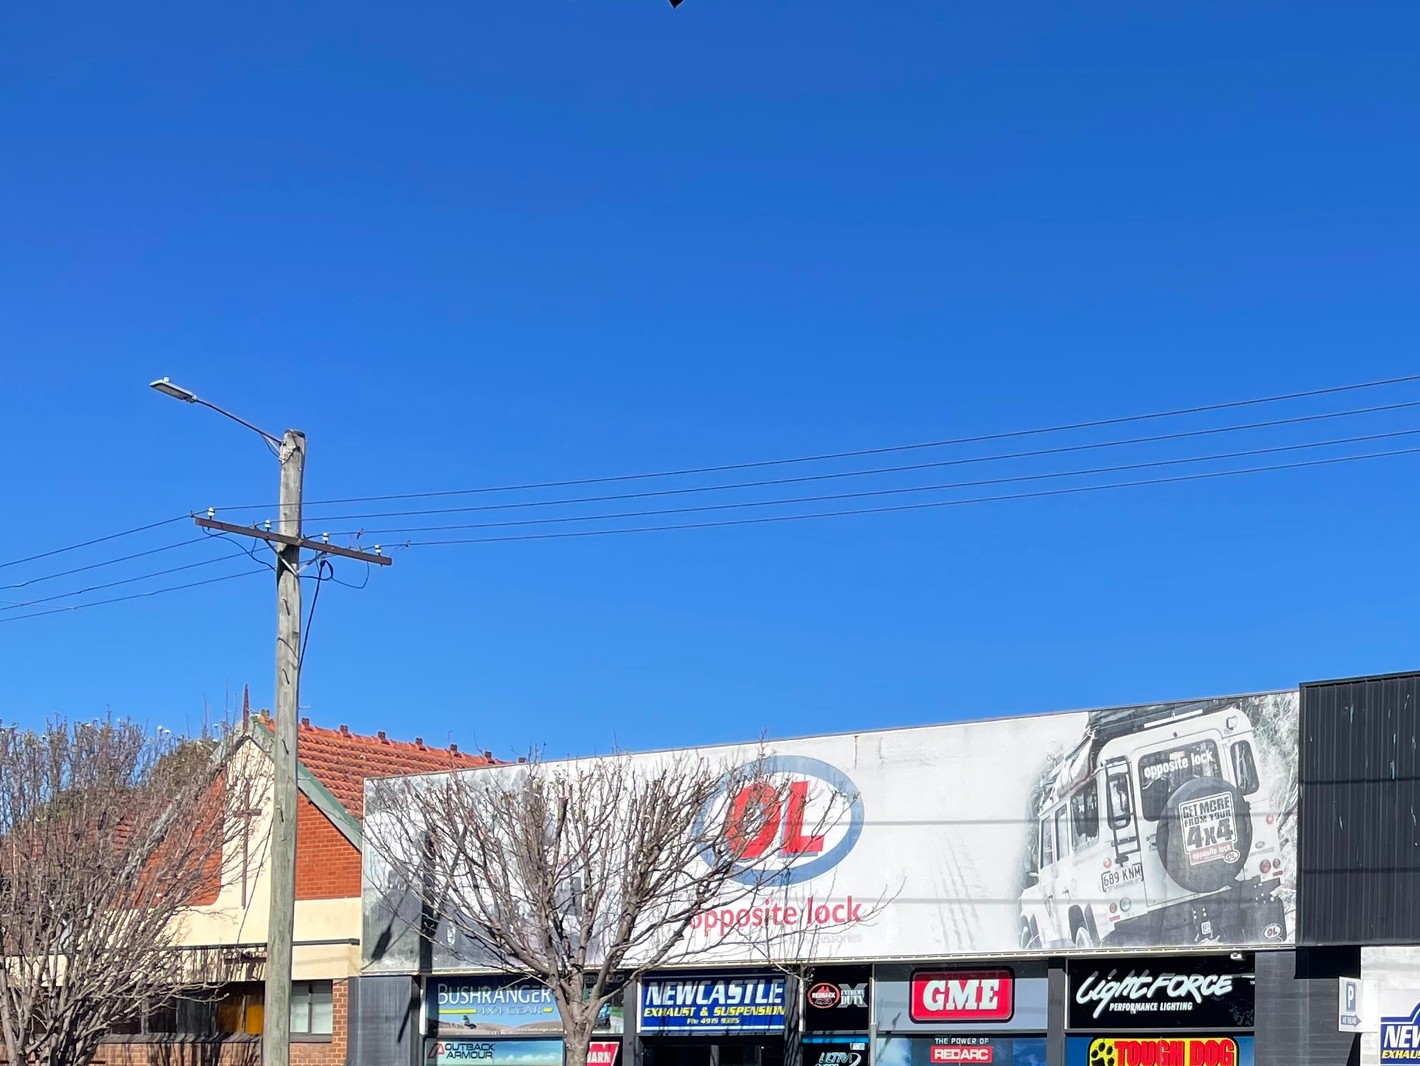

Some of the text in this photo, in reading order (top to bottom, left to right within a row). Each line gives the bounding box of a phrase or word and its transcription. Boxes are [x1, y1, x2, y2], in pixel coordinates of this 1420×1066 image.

[1144, 749, 1214, 778] opposite lock
[1182, 796, 1231, 819] GET MORE
[725, 780, 826, 859] OL
[1185, 810, 1232, 828] FROM YOUR
[1103, 863, 1142, 887] 689 KNM
[689, 894, 863, 938] opposite lock
[1266, 926, 1278, 937] OL
[437, 983, 552, 1005] BUSHRANGER
[645, 978, 785, 1006] NEWCASTLE
[840, 995, 864, 1005] DUTY
[922, 979, 1000, 1012] GME
[1347, 985, 1355, 1009] P
[506, 1006, 544, 1015] GEAR
[643, 1005, 785, 1017] EXHAUST & SUSPENSION
[1109, 1001, 1193, 1013] PERFORMANCE LIGHTING
[444, 1042, 496, 1051] OUTBACK
[934, 1037, 990, 1045] THE POWER OF
[446, 1050, 494, 1060] ARMOUR
[933, 1048, 989, 1061] REDARC
